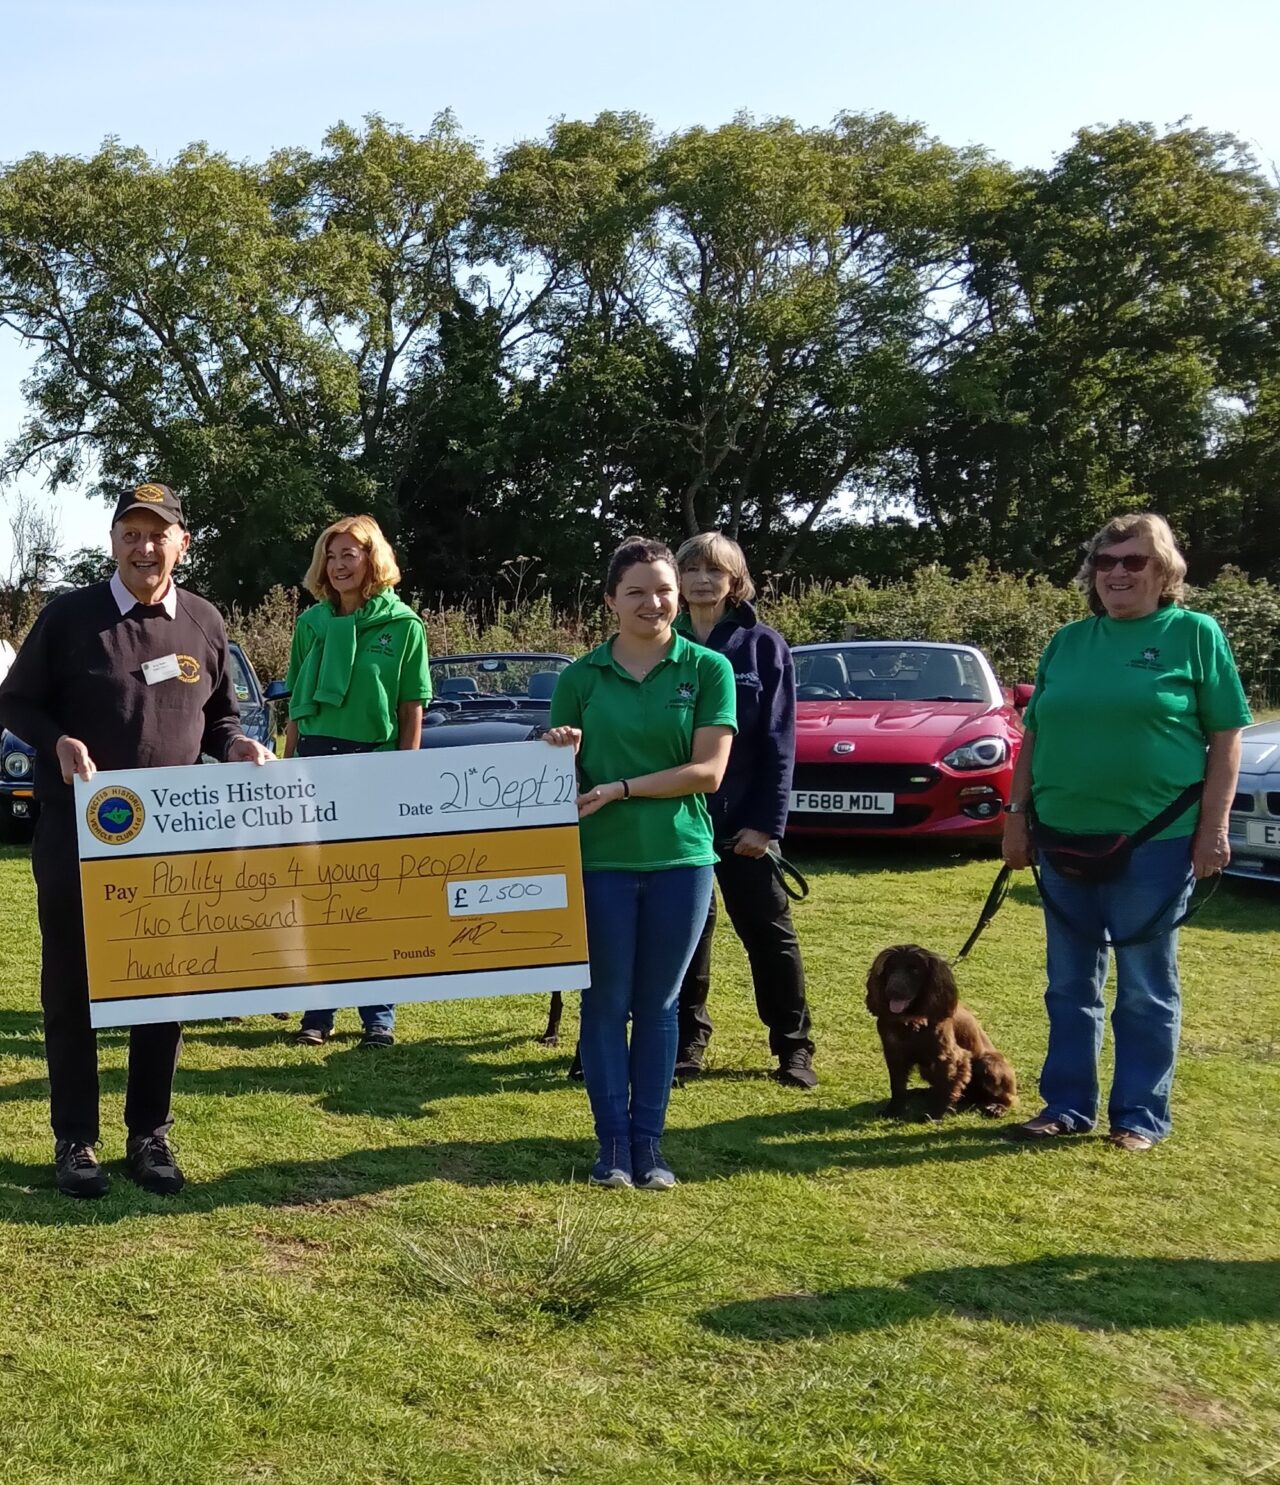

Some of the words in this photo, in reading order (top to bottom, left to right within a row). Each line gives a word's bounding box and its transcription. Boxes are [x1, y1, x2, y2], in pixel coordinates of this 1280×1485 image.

[89, 791, 109, 815] VECTIS
[111, 789, 142, 812] HISTORIC
[151, 785, 220, 808] Vectis
[226, 778, 317, 803] Historic
[478, 764, 549, 819] Sept
[796, 793, 844, 810] F688
[849, 795, 885, 811] MDL
[152, 809, 237, 834] Vehicle
[242, 804, 294, 828] Club
[300, 801, 339, 824] Ltd
[399, 803, 434, 817] Date
[90, 818, 113, 841] VEHICLE
[116, 830, 134, 841] CLUB
[1264, 825, 1280, 844] E
[152, 860, 224, 908] Ability
[235, 861, 277, 903] dogs
[287, 857, 304, 887] 4
[302, 863, 381, 901] young
[398, 848, 489, 896] people
[104, 884, 139, 904] Pay
[454, 887, 469, 909] £
[119, 902, 171, 937] Two
[178, 899, 298, 933] thousand
[322, 894, 372, 924] five
[126, 945, 219, 981] hundred
[393, 946, 436, 960] Pounds
